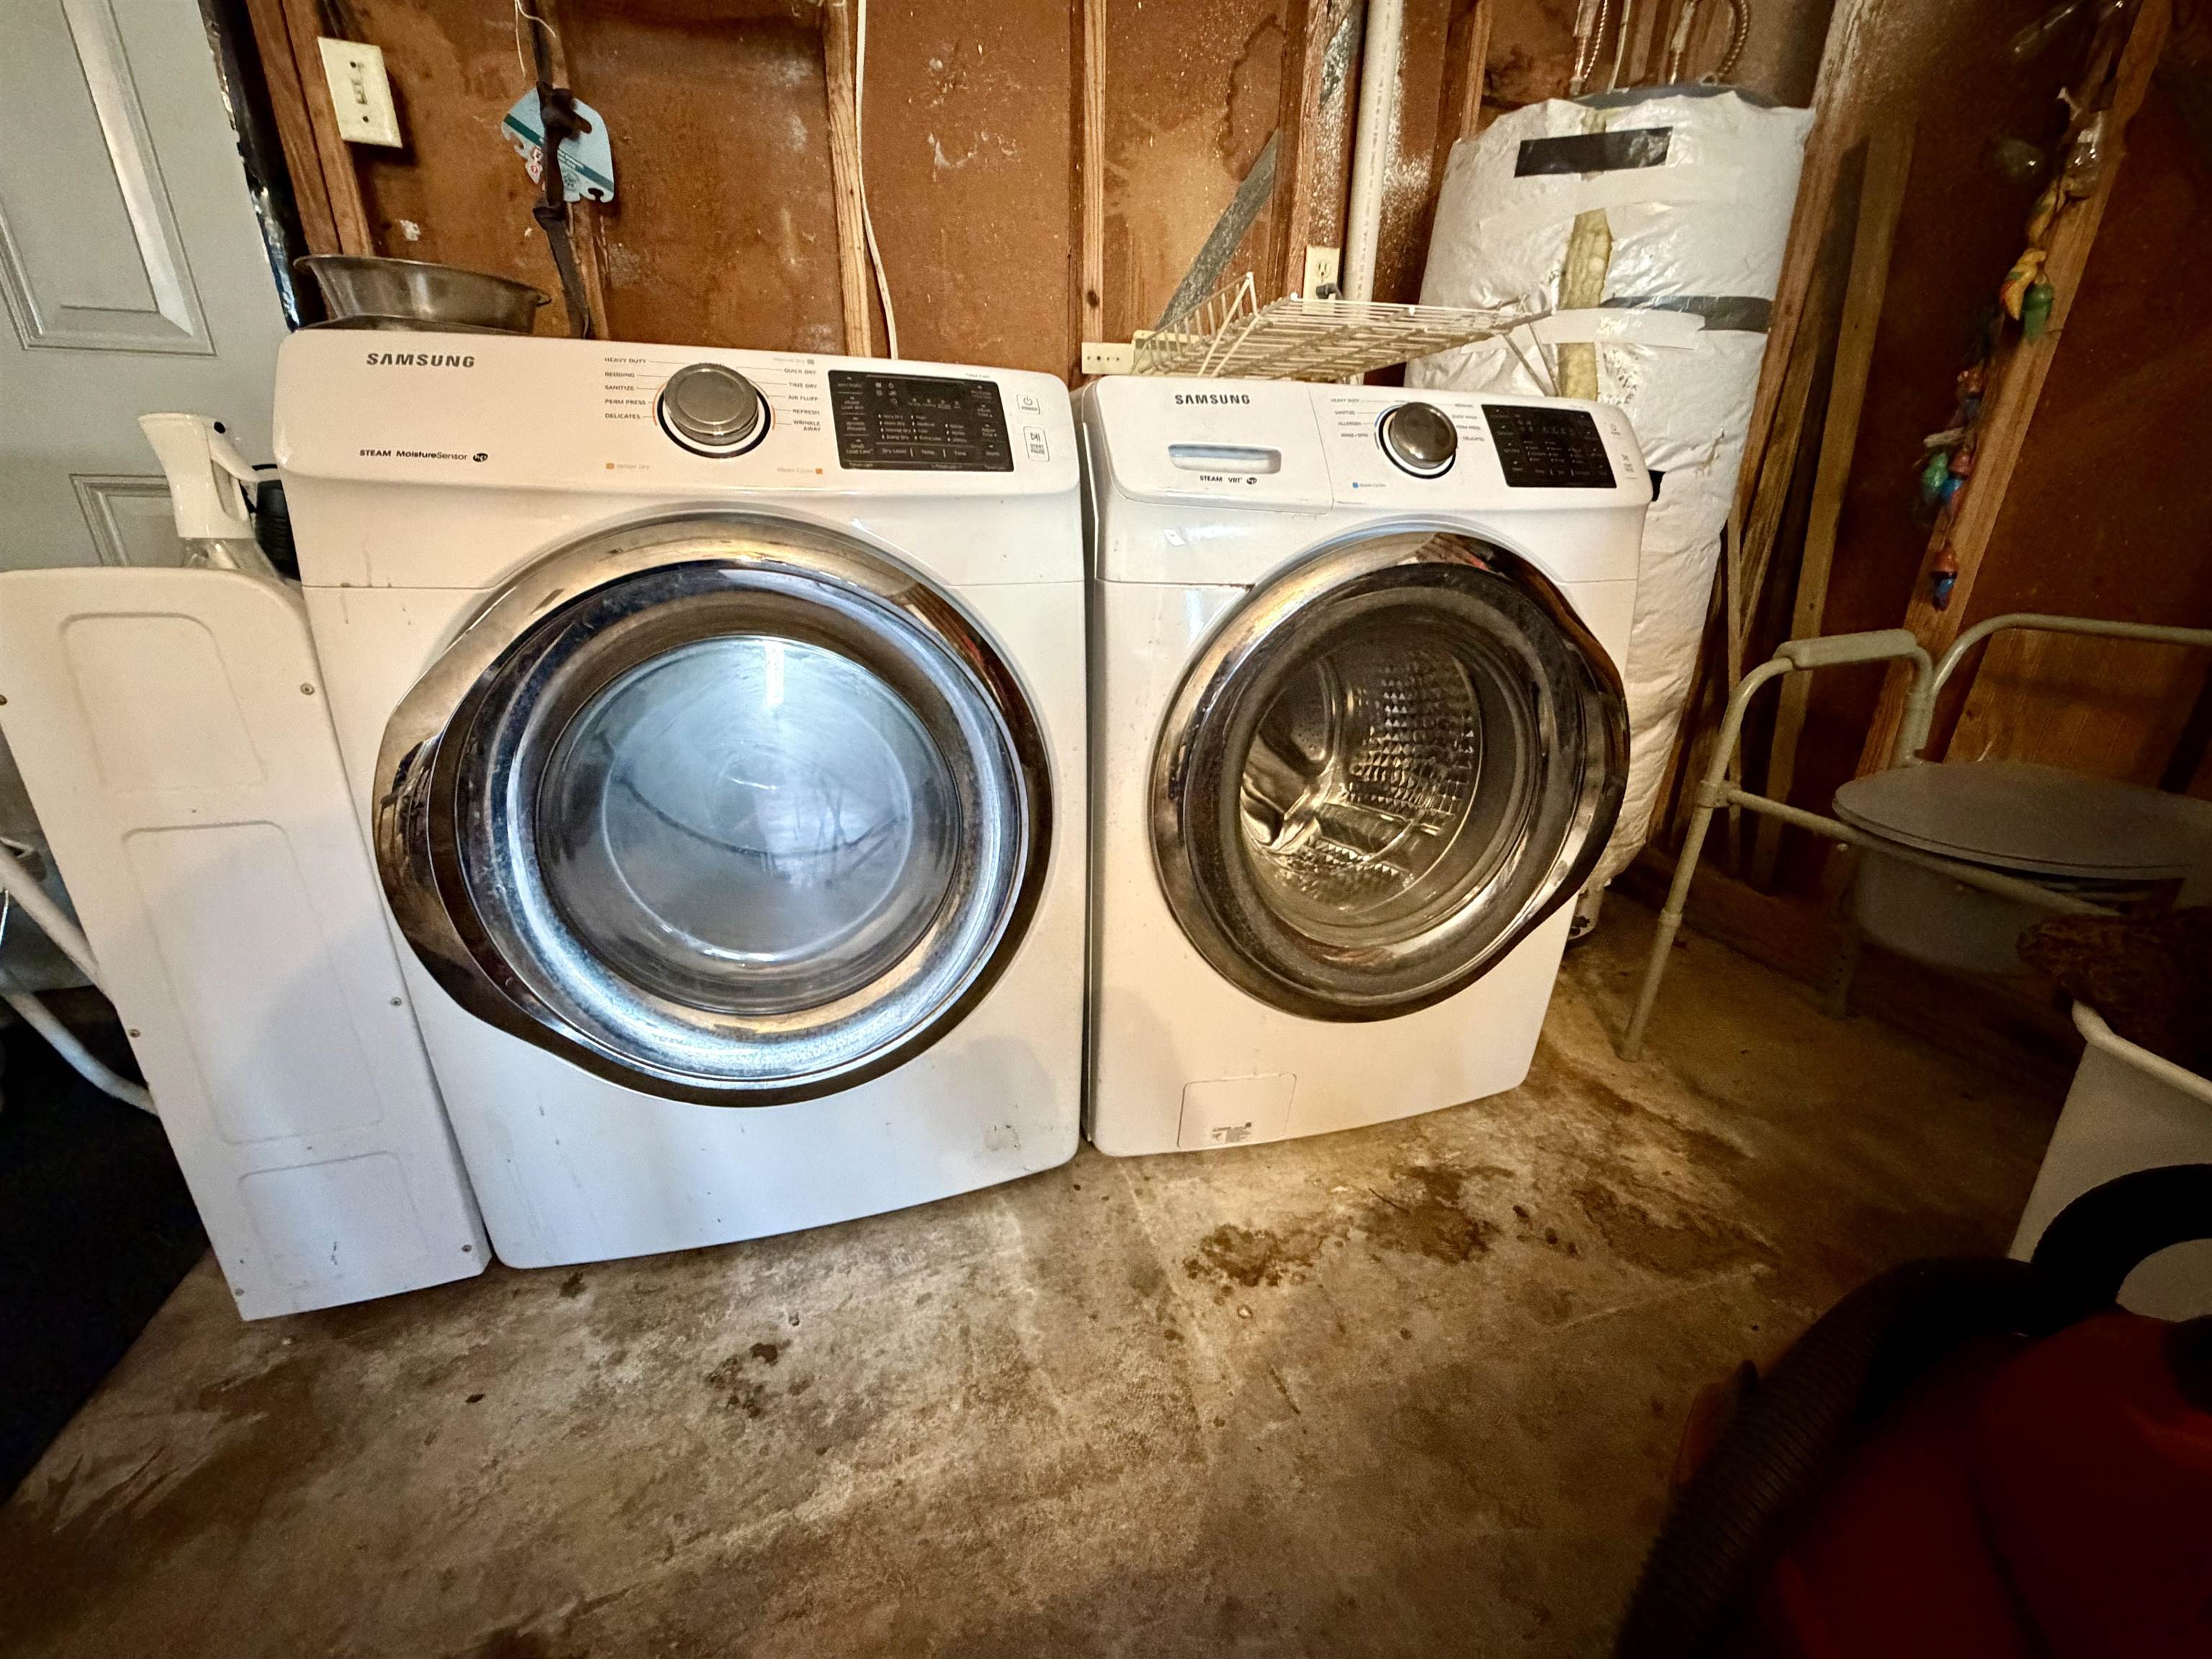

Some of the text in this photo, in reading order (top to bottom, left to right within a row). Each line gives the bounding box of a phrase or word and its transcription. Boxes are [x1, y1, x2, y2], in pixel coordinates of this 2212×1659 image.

[366, 353, 475, 368] SAMSUNG
[1174, 394, 1251, 405] SAMSUNG
[396, 450, 468, 460] MoistureSensor
